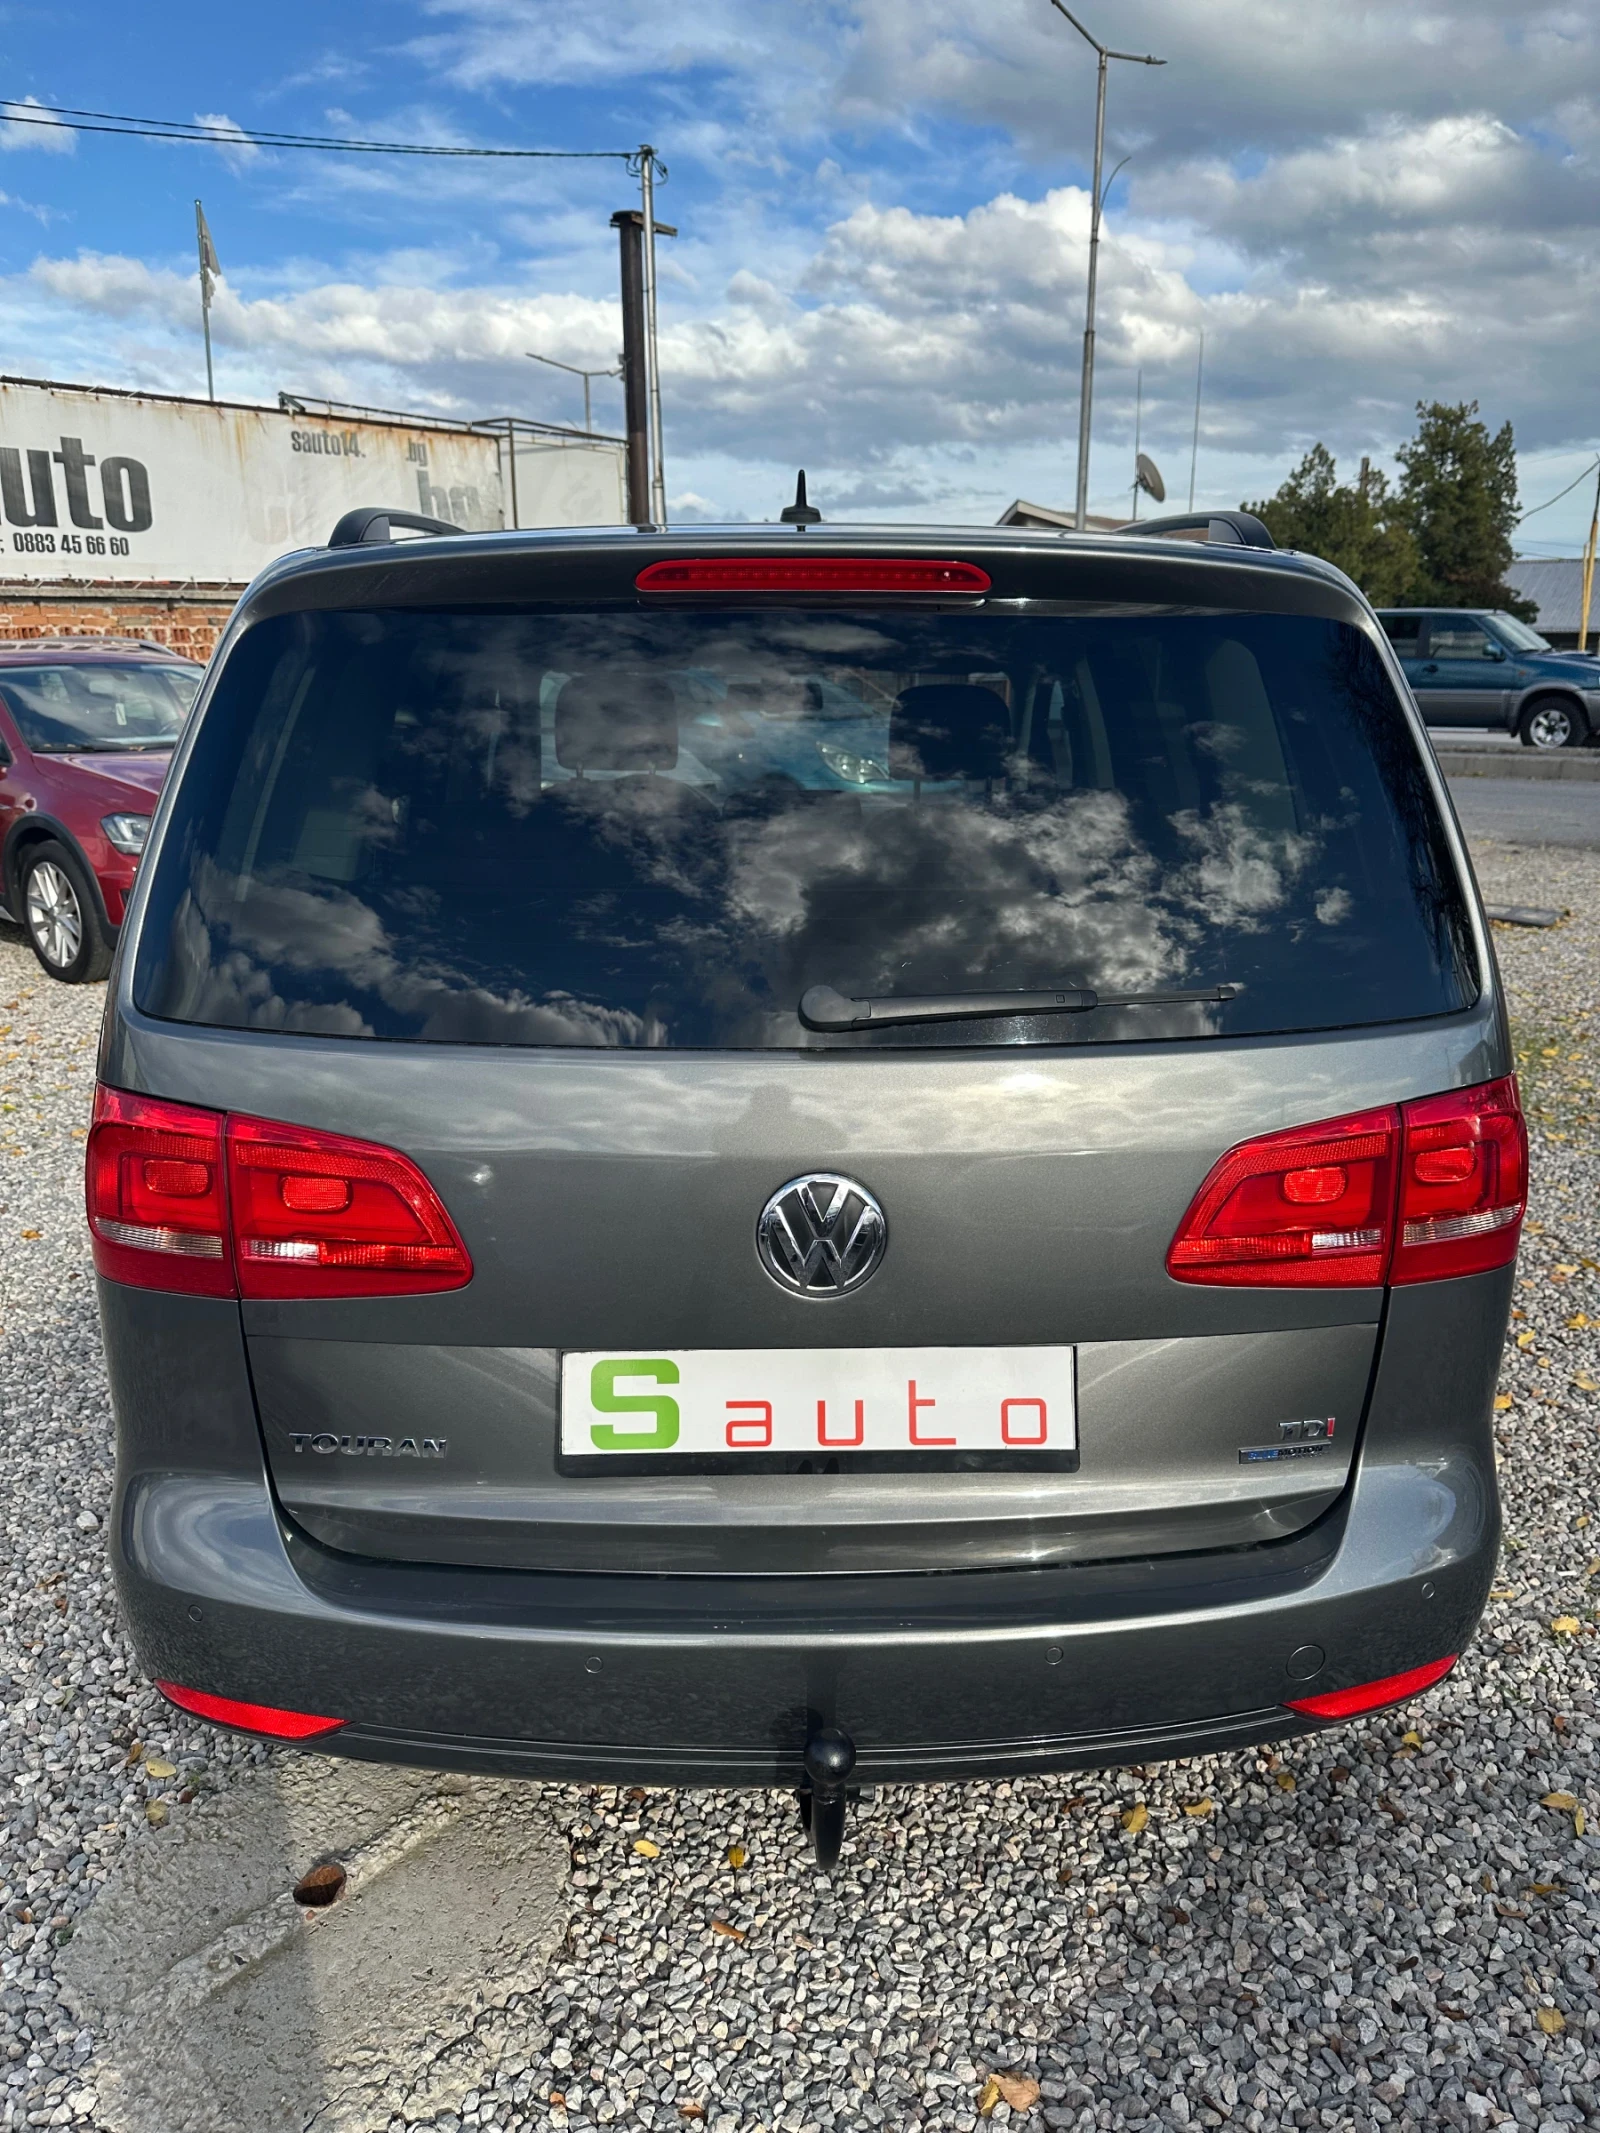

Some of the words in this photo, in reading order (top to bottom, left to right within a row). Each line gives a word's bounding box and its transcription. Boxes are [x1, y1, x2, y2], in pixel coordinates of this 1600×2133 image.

[0, 436, 153, 533] uto
[13, 532, 56, 553] 0883
[61, 534, 82, 554] 45
[86, 536, 106, 555] 66
[109, 537, 130, 556] 60
[1279, 1417, 1336, 1441] TDI
[288, 1432, 448, 1459] TOURAN
